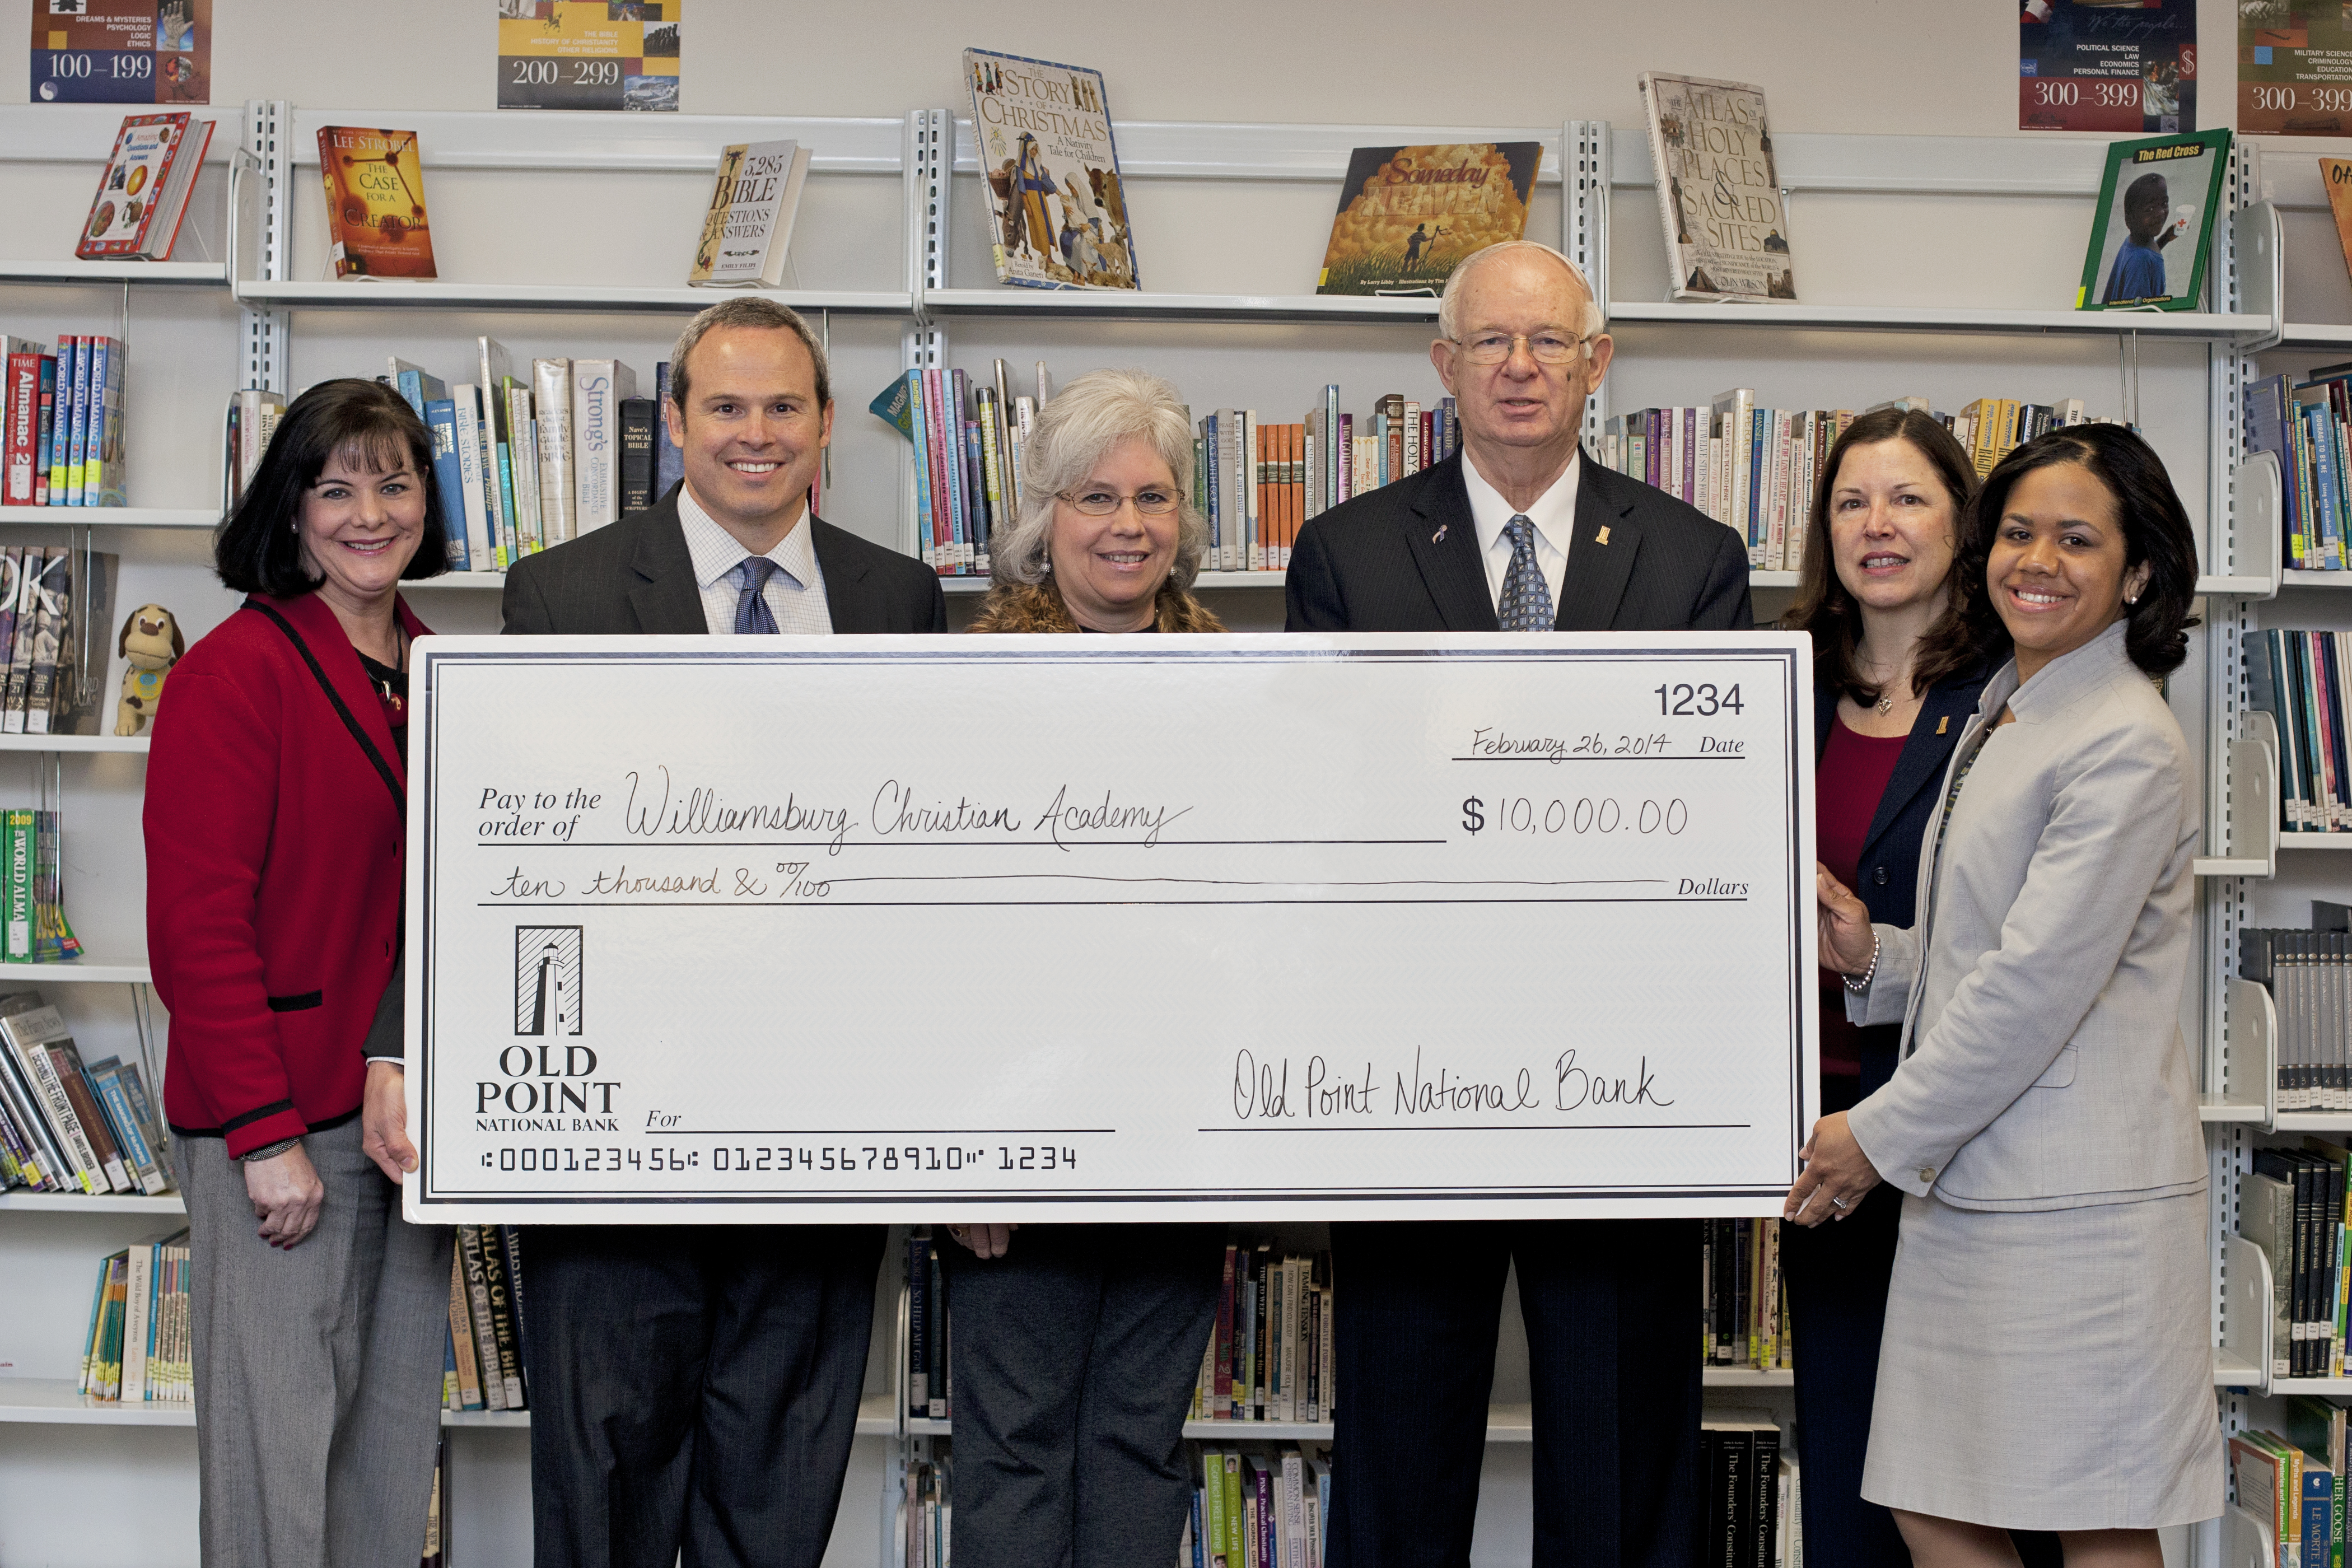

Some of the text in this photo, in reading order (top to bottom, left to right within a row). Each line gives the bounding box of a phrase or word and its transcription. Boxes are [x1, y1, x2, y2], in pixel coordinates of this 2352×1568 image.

[1005, 69, 1070, 104] STORY
[1028, 68, 1044, 78] THE
[982, 97, 1107, 142] CHRISTMAS
[1036, 100, 1046, 110] OF
[1670, 88, 1757, 125] THE ATLAS OF
[127, 143, 148, 152] Questions
[333, 134, 415, 153] LEE STROBEL
[1047, 144, 1105, 163] Tale for Children
[1057, 136, 1093, 151] A Nativity
[1688, 120, 1747, 157] HOLY
[2139, 145, 2200, 161] The Red Cross
[359, 173, 399, 190] CASE
[366, 162, 388, 174] THE
[745, 155, 784, 178] 3,285
[1387, 158, 1490, 188] Someday
[1681, 148, 1765, 187] PLACES
[366, 192, 387, 202] FOR
[710, 175, 777, 210] BIBLE
[1360, 183, 1505, 217] HEAVEN
[1683, 185, 1776, 224] SACRED
[1714, 171, 1742, 207] &
[344, 208, 424, 231] CREATOR
[705, 208, 771, 226] QUESTIONS
[713, 225, 766, 240] ANSWERS
[1706, 217, 1762, 253] SITES
[1009, 267, 1044, 279] Anita Ganeri
[1715, 276, 1767, 290] COLIN WILSON
[12, 358, 35, 367] TIME
[16, 371, 34, 447] Almanac
[54, 357, 66, 441] WORLD ALMANAC
[579, 377, 609, 452] Strong's
[1407, 409, 1418, 466] THE HOLY
[2320, 454, 2326, 463] BE
[2321, 465, 2327, 474] ME
[582, 483, 590, 505] BIBLE
[590, 457, 599, 515] CONCORDANCE
[599, 463, 608, 509] EXHAUSTIVE
[1654, 683, 1744, 716] 1234
[1472, 726, 1568, 764] February
[1614, 733, 1673, 755] 2014
[1699, 736, 1744, 754] Date
[478, 786, 602, 814] Pay to the
[626, 764, 1194, 856] Williamsburg Christian Academy
[1462, 795, 1485, 836] $
[9, 814, 32, 825] 2009
[478, 814, 580, 842] order of
[1500, 797, 1688, 835] 10,000.00
[13, 837, 27, 883] WORLD
[489, 865, 566, 898] ten
[581, 865, 721, 895] thousand
[734, 868, 767, 897] &
[1677, 877, 1749, 896] Dollars
[500, 1045, 598, 1077] OLD
[1234, 1044, 1674, 1119] Old Point National Bank
[475, 1082, 621, 1114] POINT
[475, 1118, 620, 1131] NATIONAL BANK
[645, 1110, 682, 1128] For
[998, 1146, 1076, 1170] 1234
[463, 1229, 494, 1341] ATLAS OF THE
[1727, 1452, 1738, 1522] The Founders'
[2334, 1504, 2343, 1543] GOOSE
